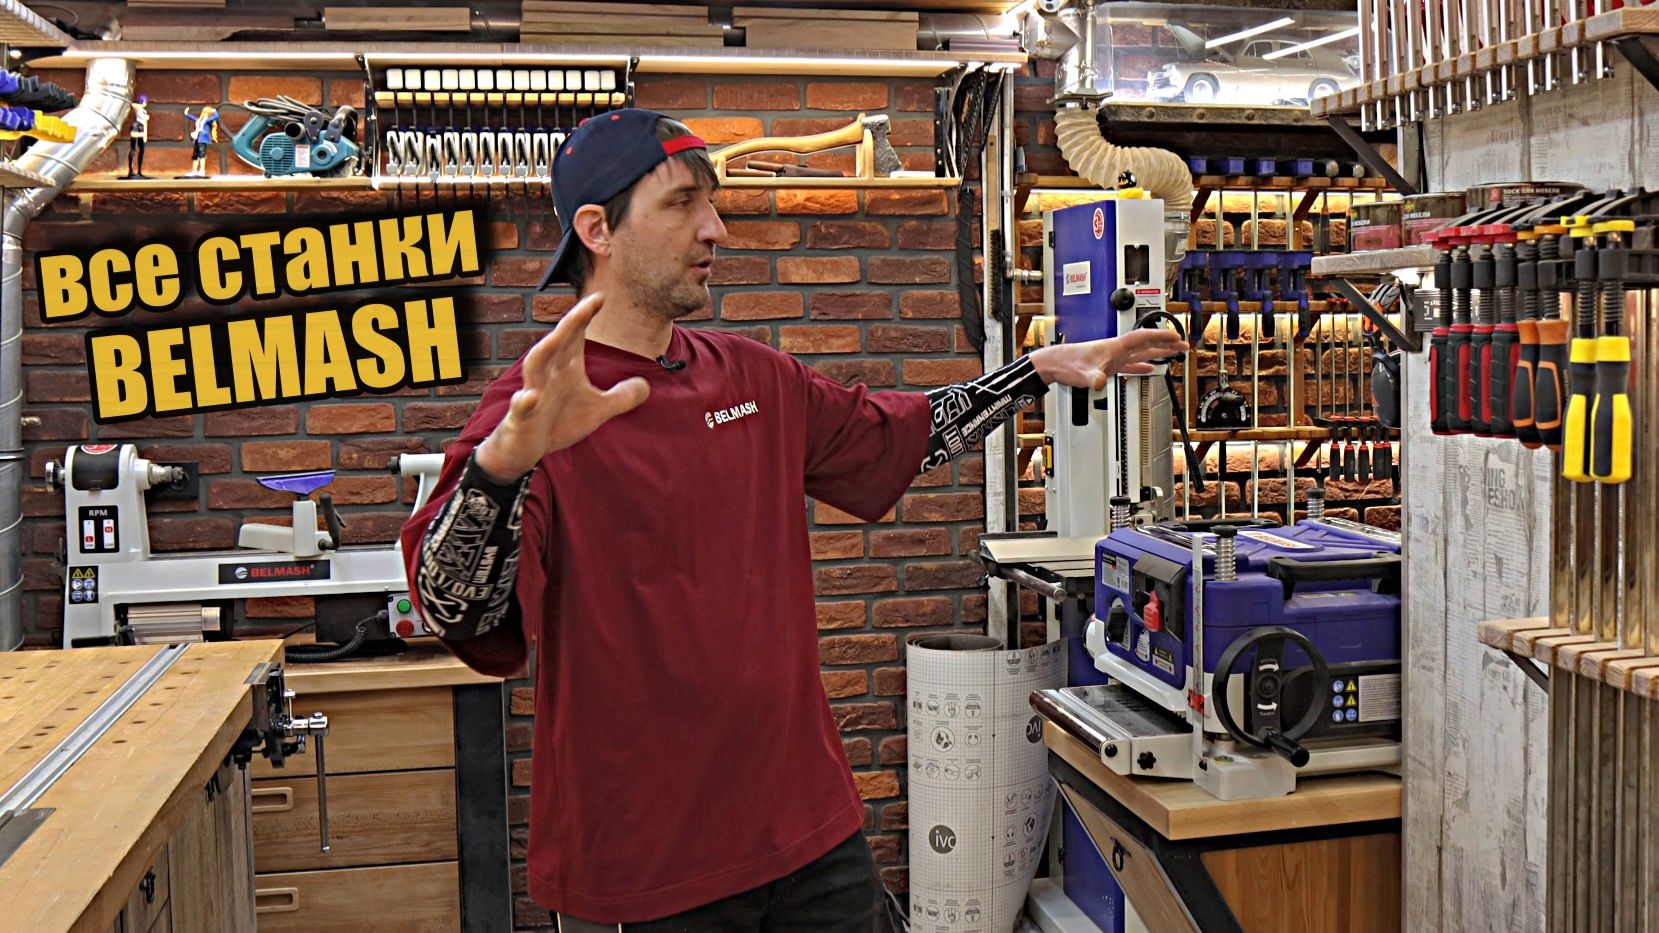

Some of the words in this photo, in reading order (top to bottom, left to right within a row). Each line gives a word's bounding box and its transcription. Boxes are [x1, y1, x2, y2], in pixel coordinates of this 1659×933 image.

[714, 400, 758, 424] BELMASH
[88, 509, 108, 517] RPM
[251, 566, 311, 578] BELMASH
[935, 829, 955, 849] ivc
